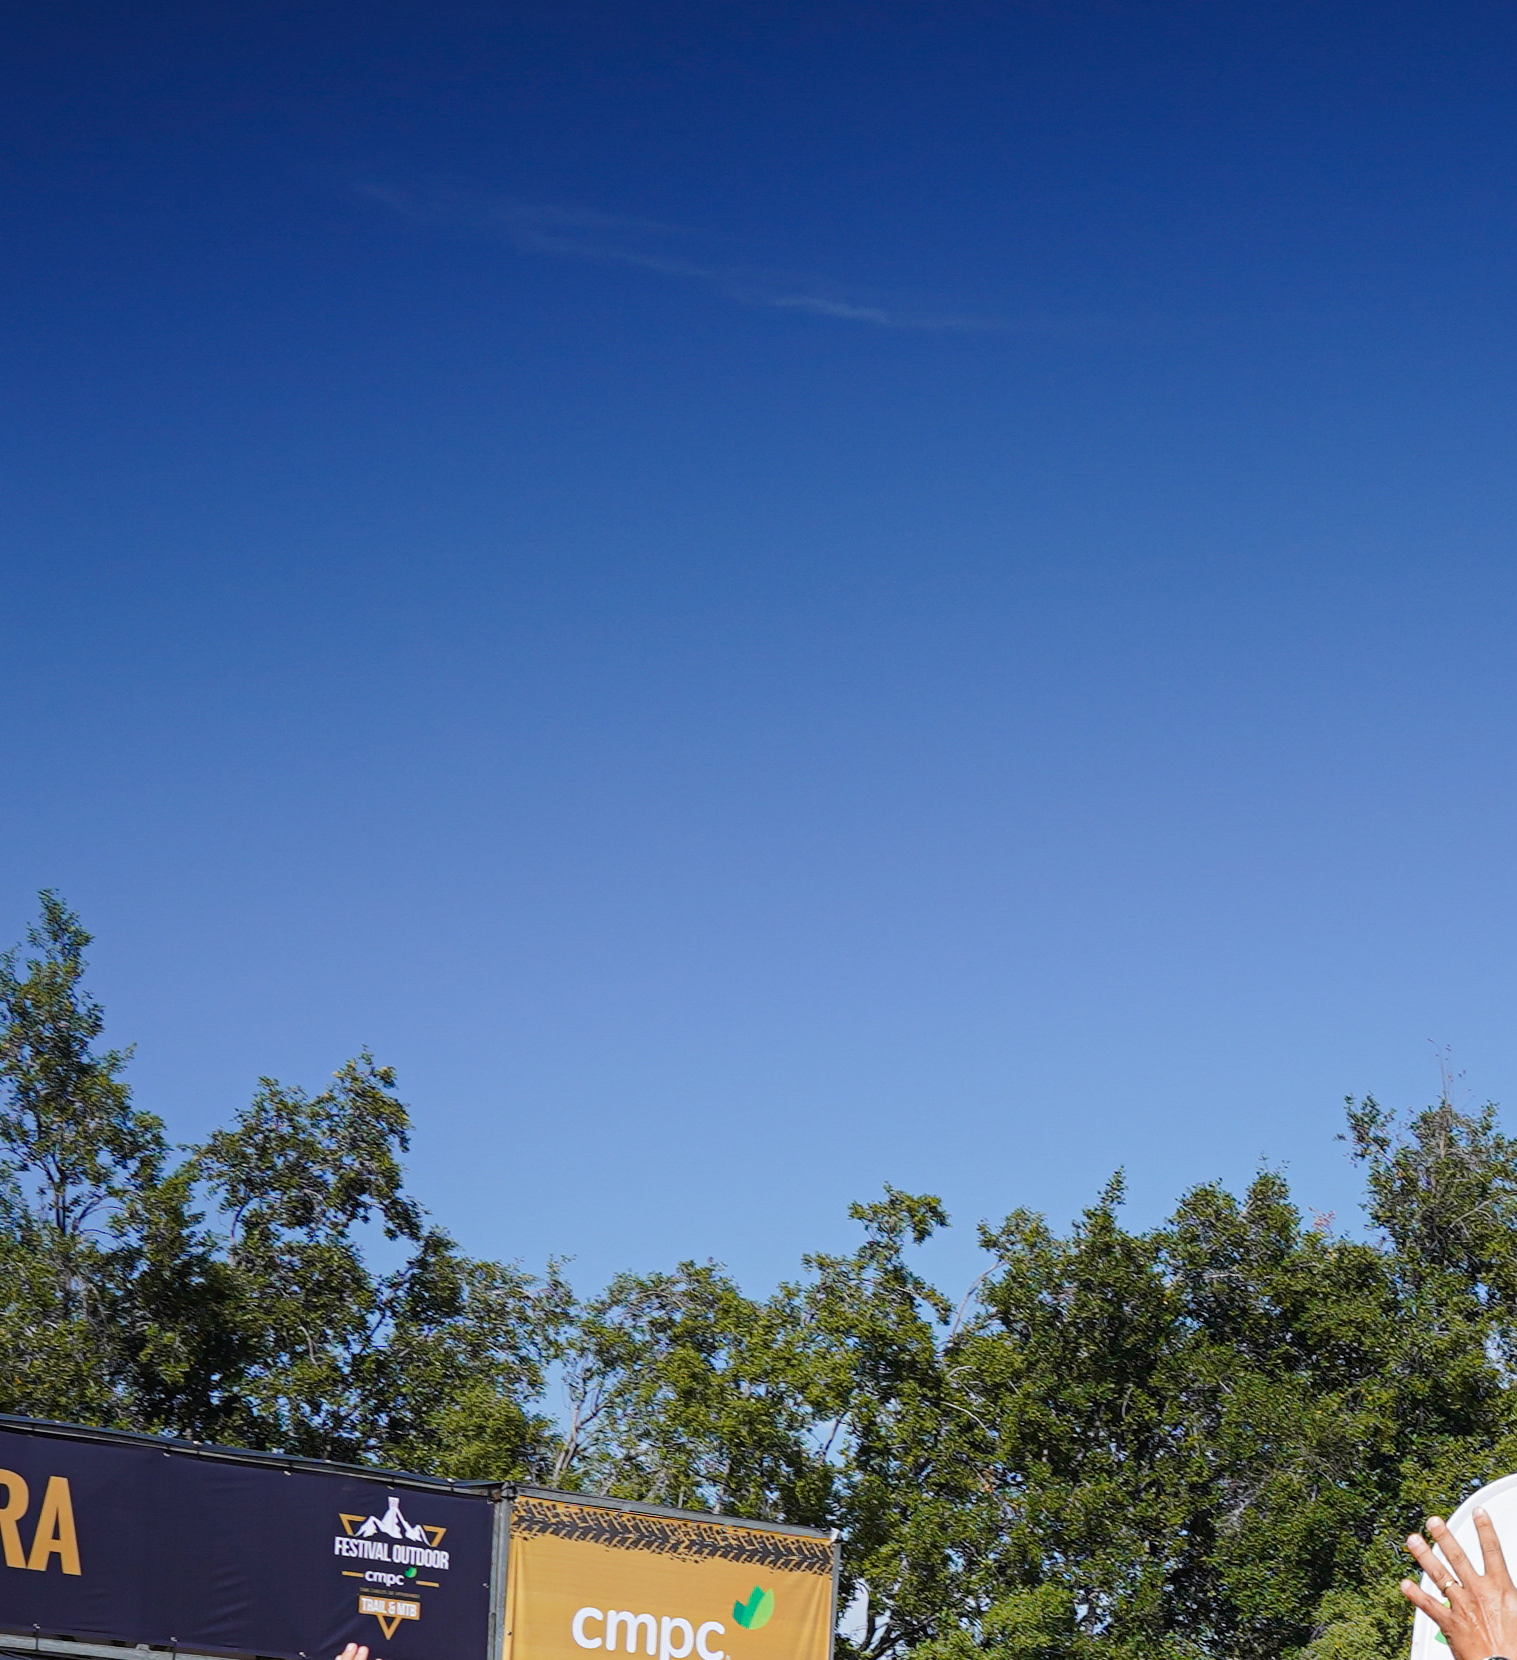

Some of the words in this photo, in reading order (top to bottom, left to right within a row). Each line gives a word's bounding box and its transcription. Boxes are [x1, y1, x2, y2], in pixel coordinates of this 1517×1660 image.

[334, 1536, 392, 1562] FESTIVAL
[392, 1544, 450, 1570] OUTDOOR
[364, 1570, 405, 1587] cmpc
[360, 1598, 387, 1614] TRAIL
[396, 1602, 418, 1617] MTB
